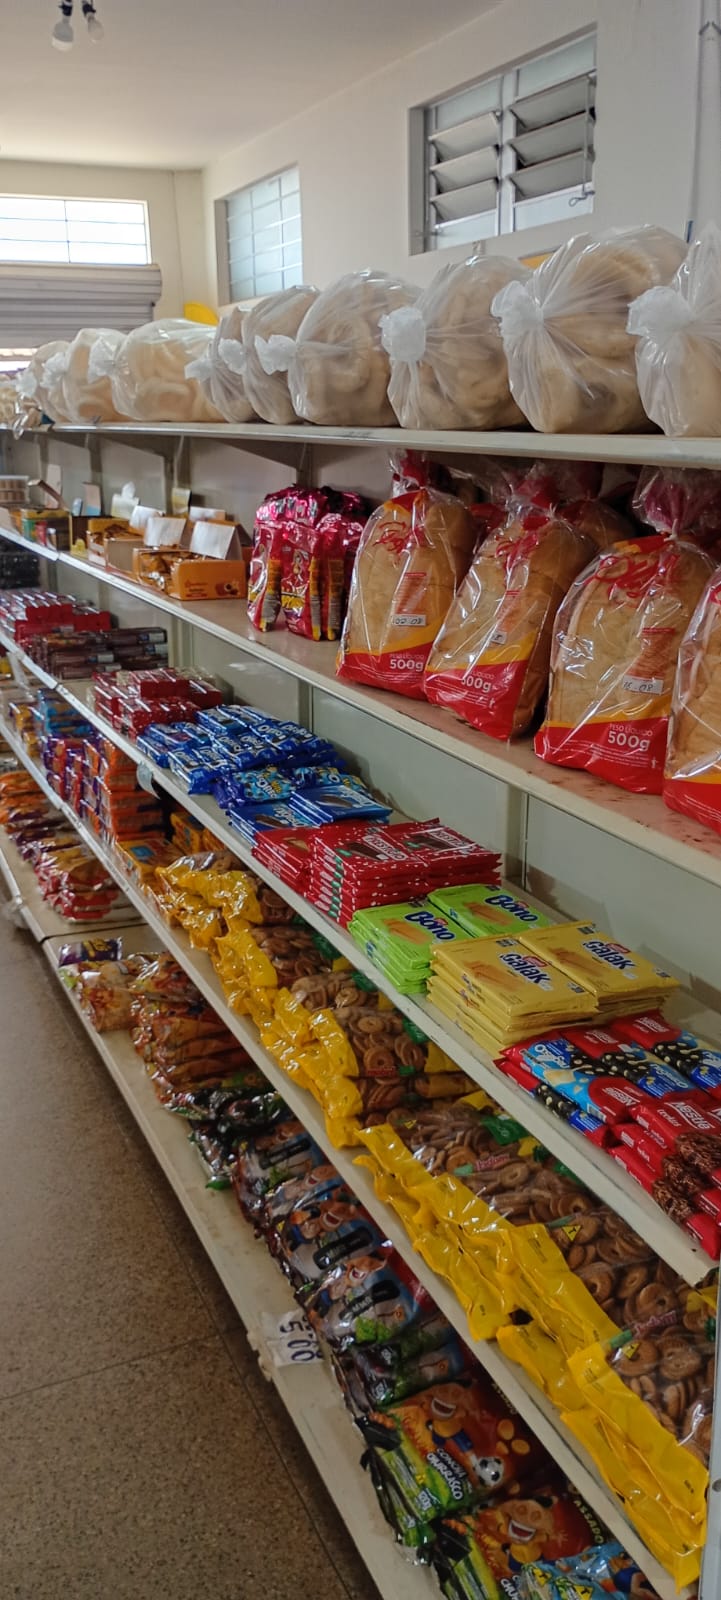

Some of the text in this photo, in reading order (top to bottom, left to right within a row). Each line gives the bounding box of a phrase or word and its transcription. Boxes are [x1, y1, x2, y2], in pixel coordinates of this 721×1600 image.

[389, 659, 424, 672] 500g
[607, 731, 651, 752] 500g
[484, 894, 538, 922] Bono
[404, 910, 455, 940] Bono
